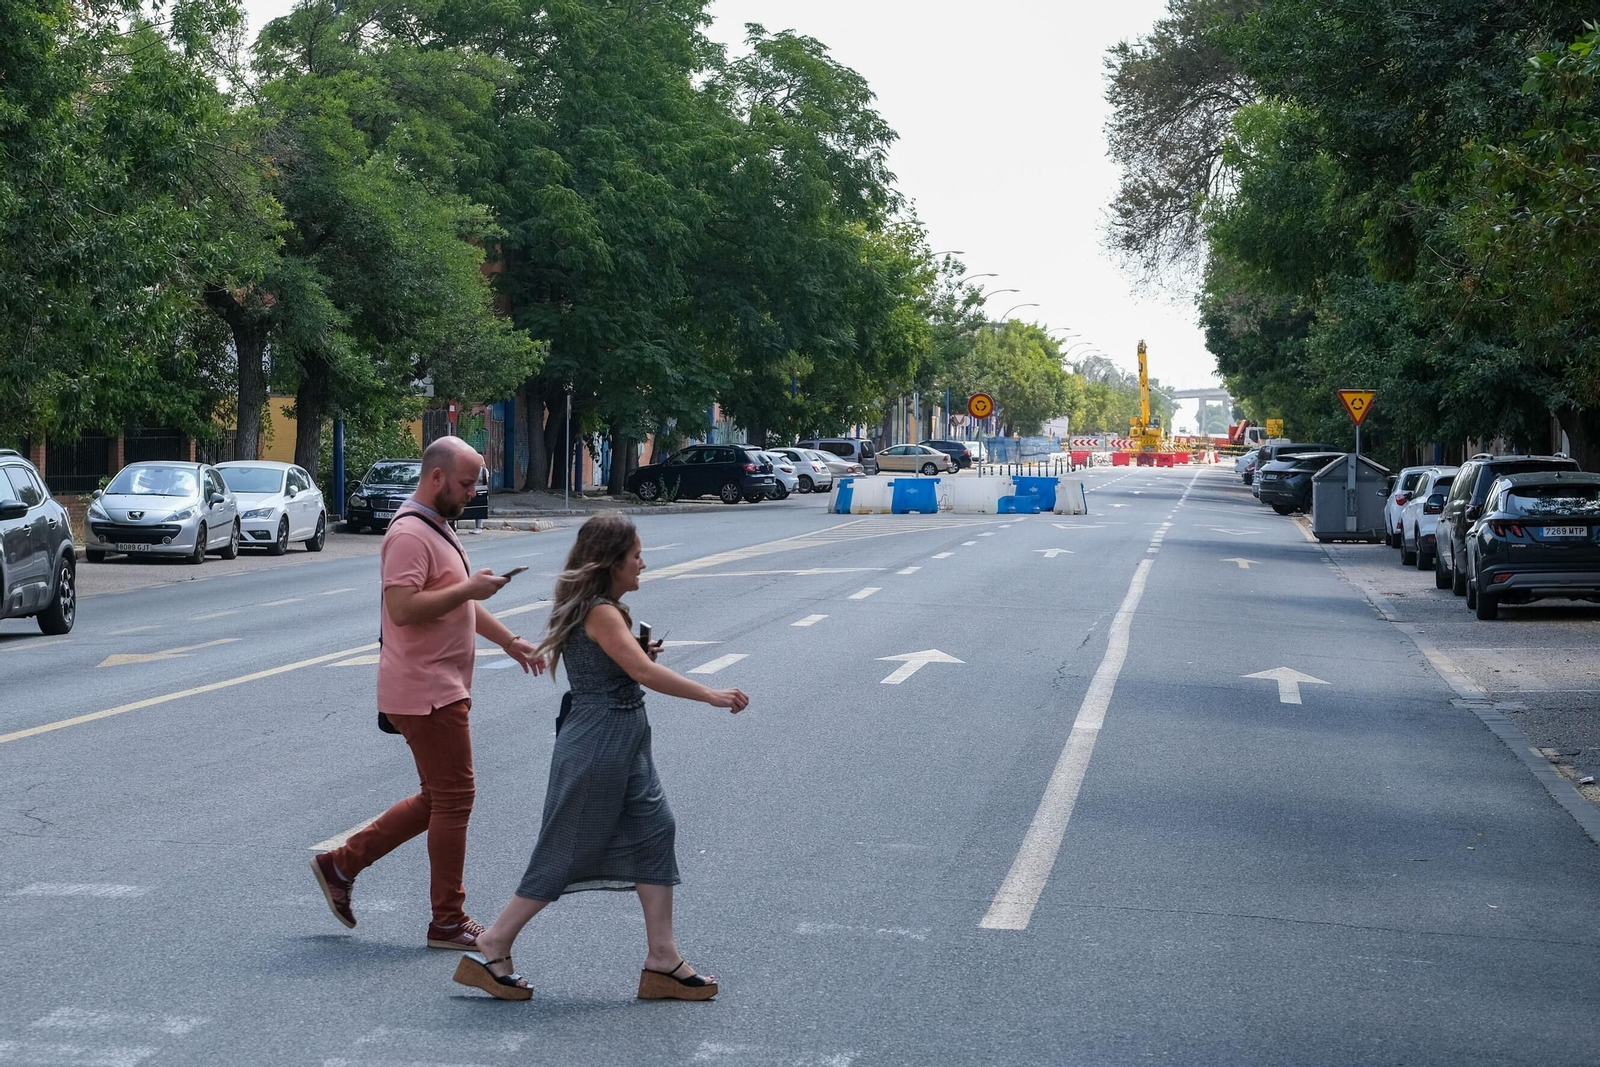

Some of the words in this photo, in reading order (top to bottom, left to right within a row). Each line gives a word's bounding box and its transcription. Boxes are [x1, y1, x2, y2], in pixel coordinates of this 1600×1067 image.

[1545, 527, 1567, 535] 7269
[1568, 527, 1585, 535] MTP
[119, 543, 136, 551] 8089
